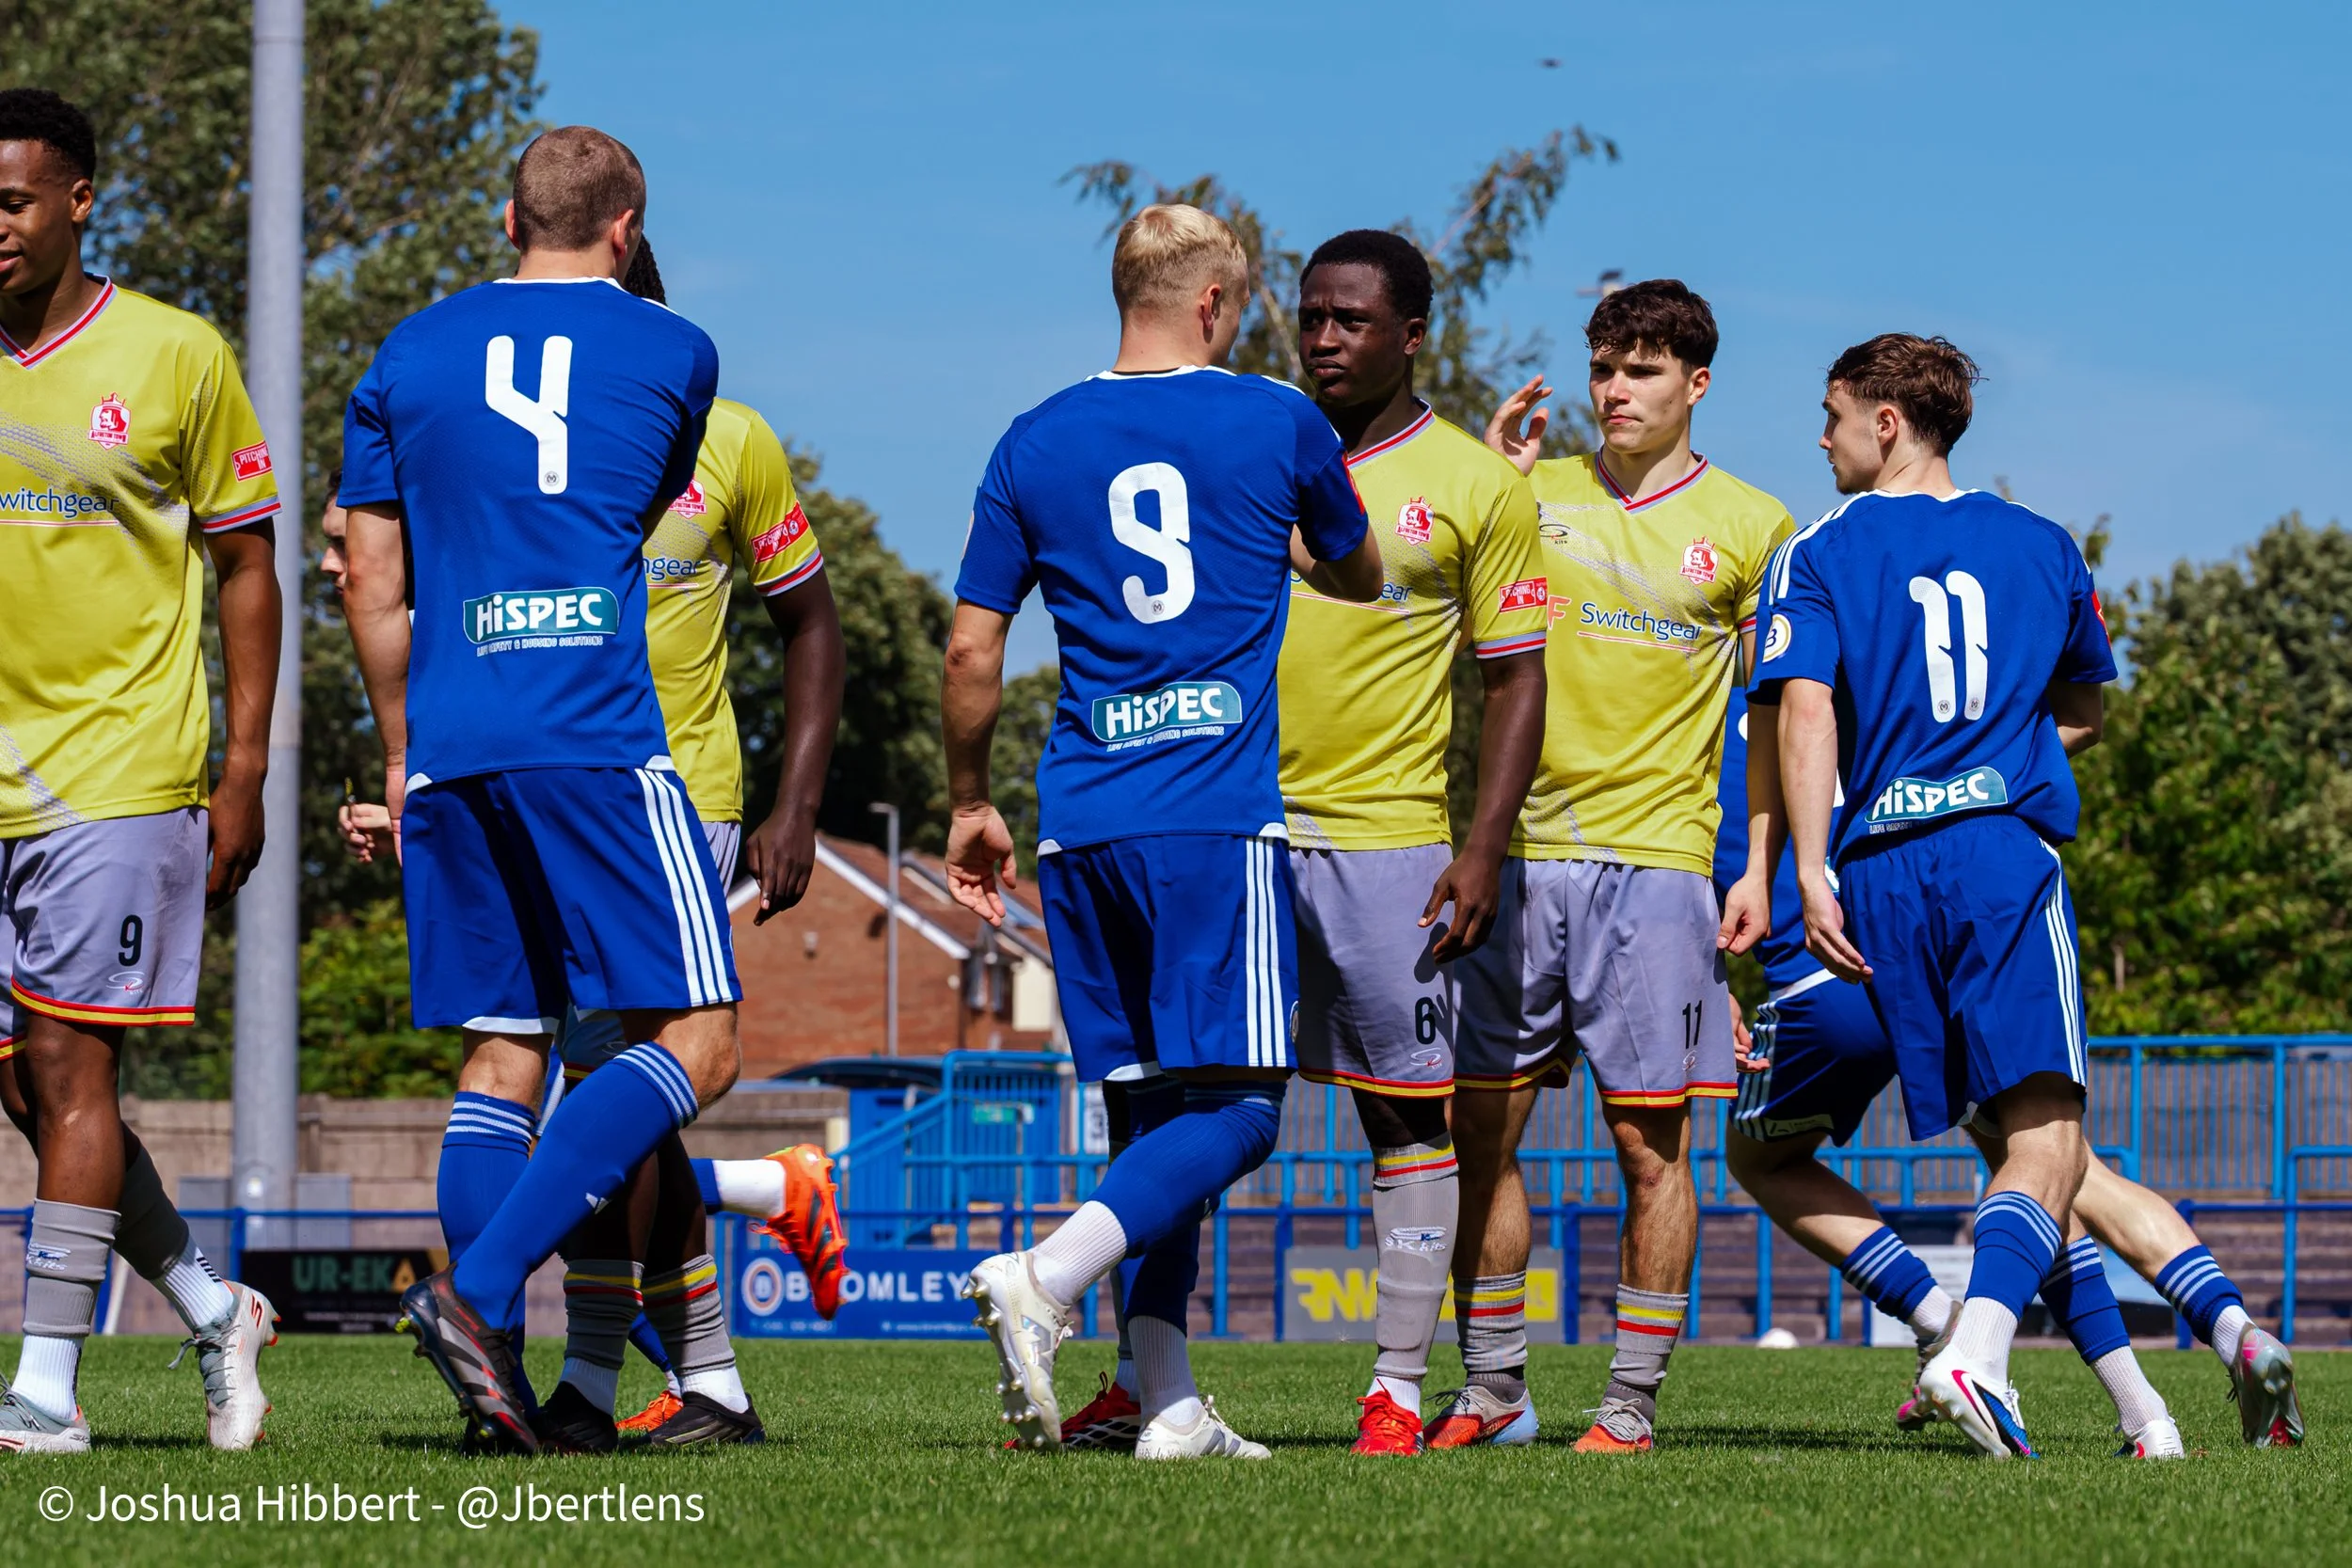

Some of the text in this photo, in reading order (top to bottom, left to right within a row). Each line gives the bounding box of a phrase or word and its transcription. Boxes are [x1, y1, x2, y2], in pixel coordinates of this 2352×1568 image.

[485, 335, 573, 495] 4
[0, 487, 119, 518] witchgear
[1108, 462, 1195, 624] 9
[559, 635, 604, 647] SOLUTIONS
[1581, 602, 1703, 641] Switchgear
[1909, 570, 1988, 723] 11
[119, 914, 143, 967] 9
[1414, 997, 1437, 1044] 6
[1682, 1000, 1702, 1050] 11
[785, 1271, 970, 1303] BOMLEY
